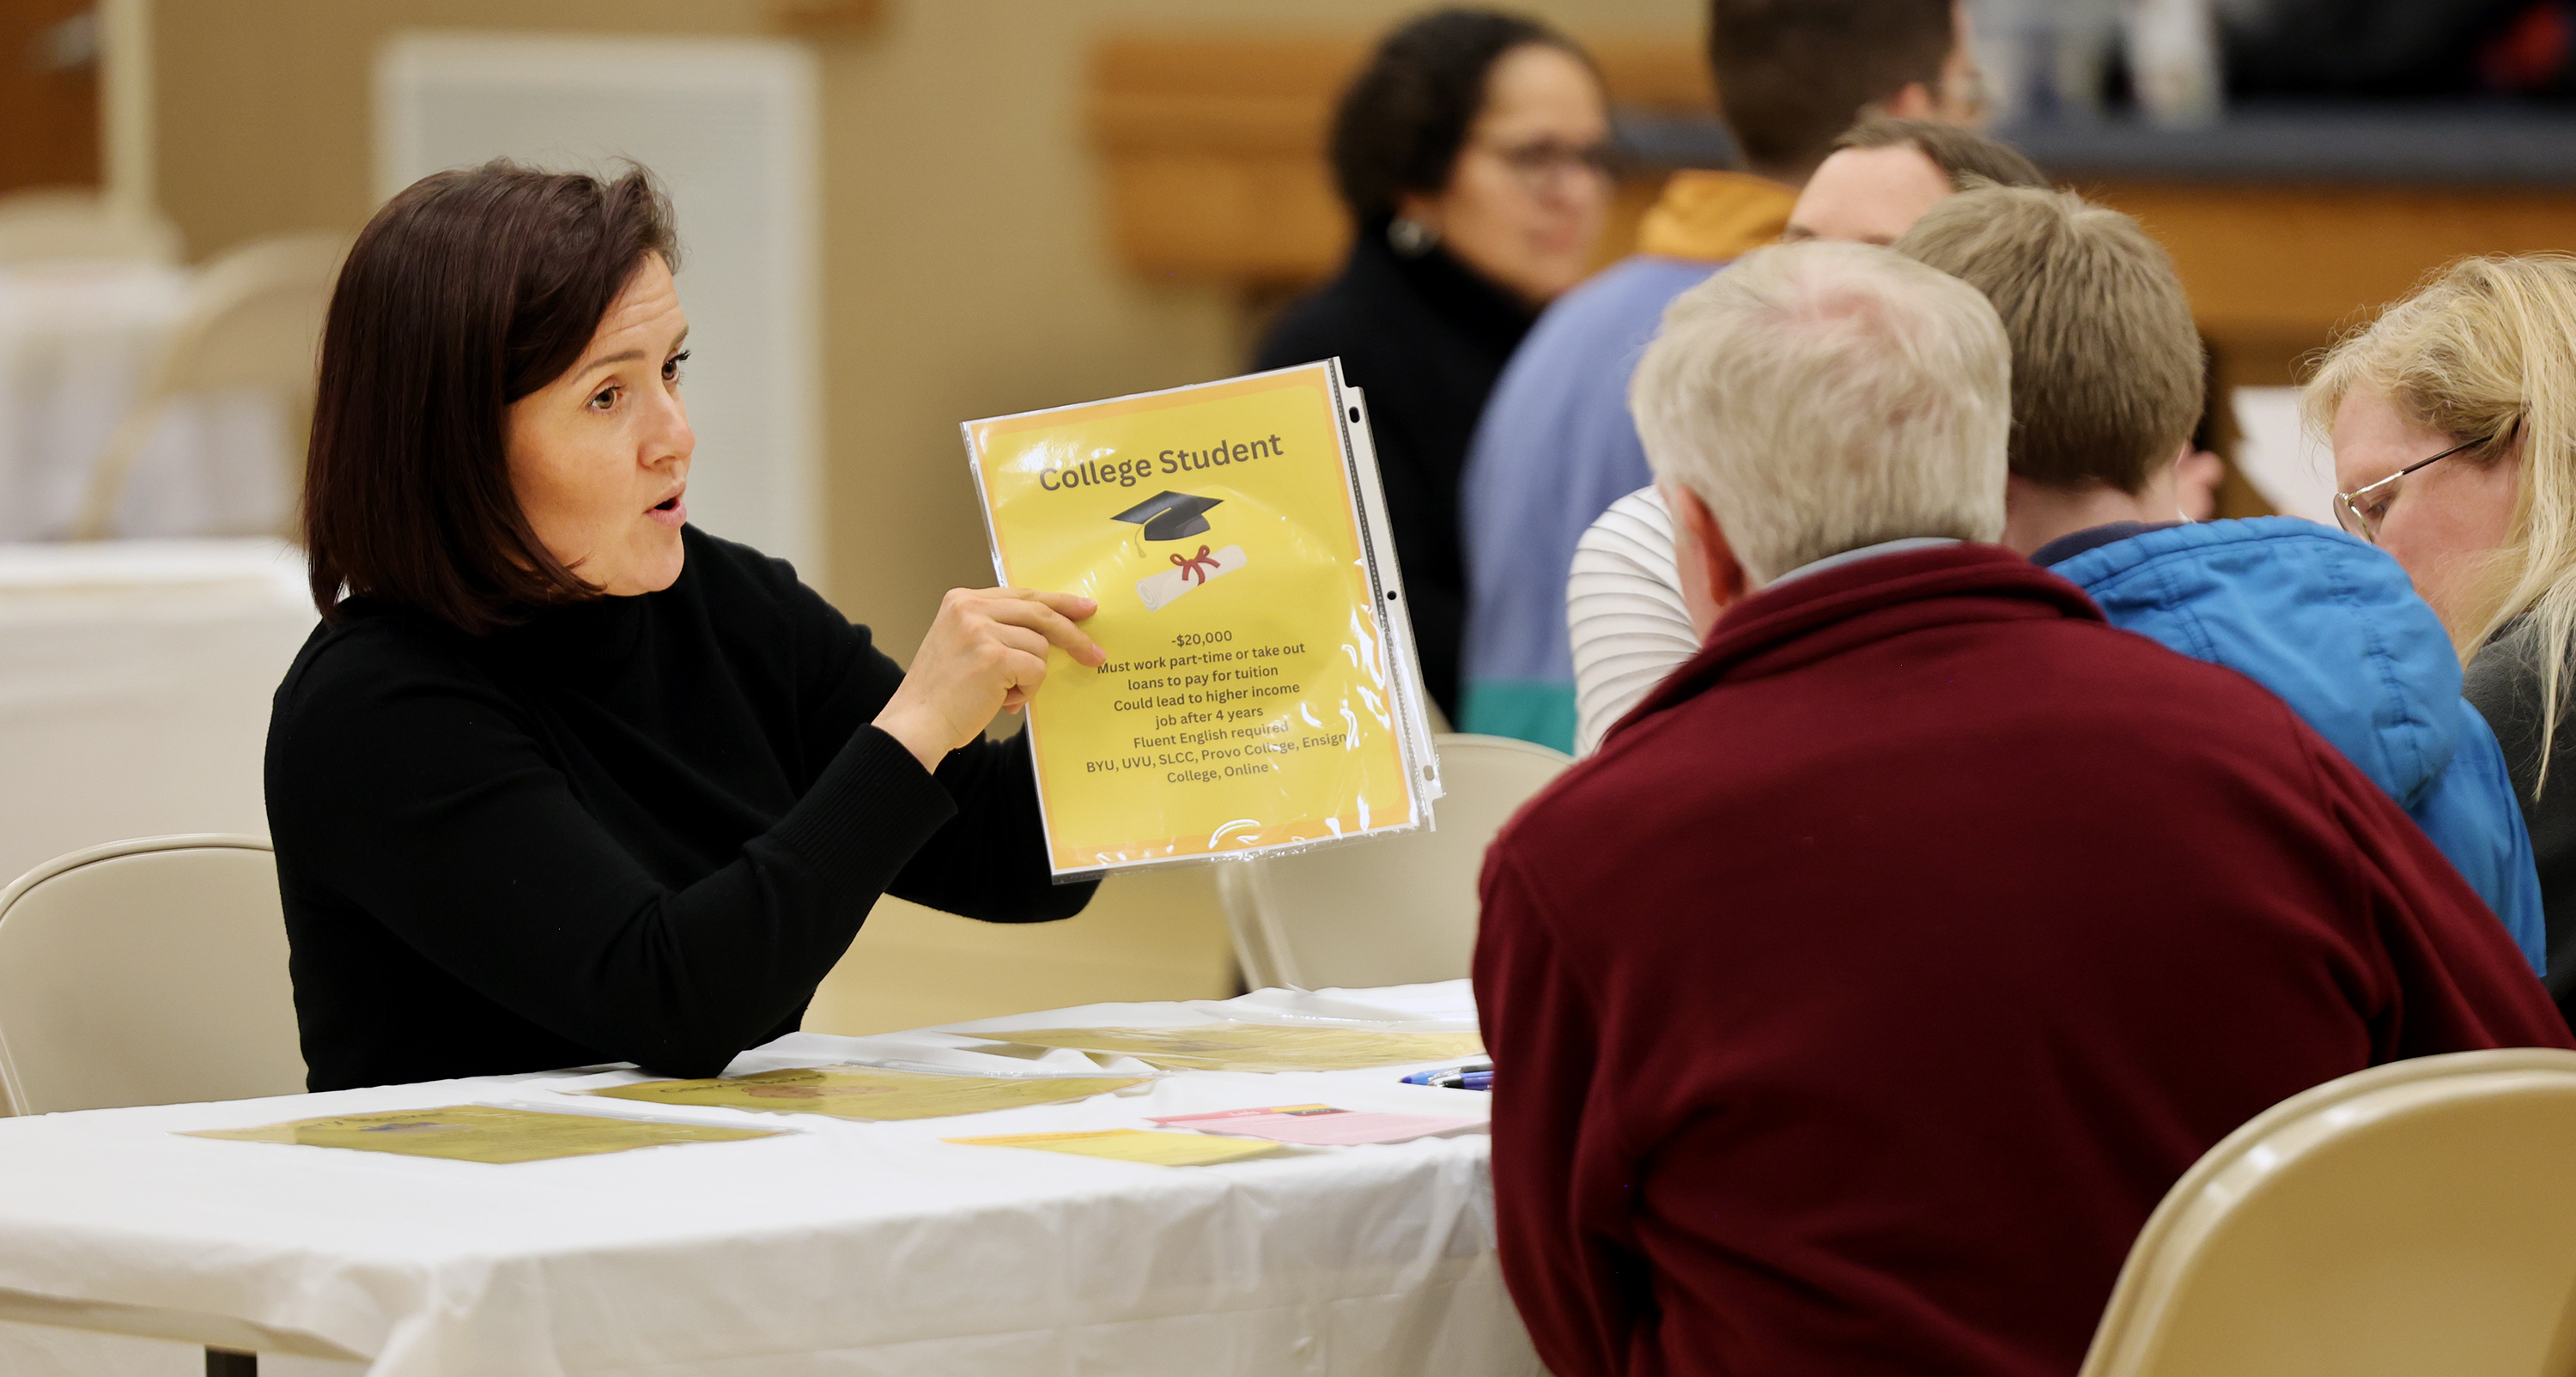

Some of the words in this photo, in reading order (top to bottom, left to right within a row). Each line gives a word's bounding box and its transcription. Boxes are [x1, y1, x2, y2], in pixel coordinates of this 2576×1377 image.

[1040, 458, 1152, 491] College
[1159, 434, 1284, 473] Student
[1171, 630, 1232, 647] -$20,000
[1097, 661, 1130, 674] Must
[1133, 657, 1166, 670] work
[1170, 651, 1232, 670] part-time
[1236, 649, 1249, 659] or
[1252, 646, 1279, 658] take
[1283, 643, 1305, 654] out
[1128, 678, 1163, 690] loans
[1167, 676, 1182, 686] to
[1185, 673, 1209, 688] pay
[1212, 670, 1231, 682] for
[1235, 666, 1279, 679] tuition
[1114, 697, 1153, 712] Could
[1157, 694, 1185, 707] lead
[1188, 694, 1202, 704] to
[1206, 688, 1248, 704] higher
[1252, 683, 1300, 697] income
[1156, 714, 1177, 730] job
[1181, 712, 1212, 725] after
[1216, 710, 1224, 720] 4
[1227, 707, 1263, 723] years
[1133, 735, 1176, 749] Fluent
[1180, 729, 1228, 744] English
[1231, 721, 1289, 738] required
[1086, 760, 1119, 773] BYU,
[1122, 755, 1156, 768] UVU,
[1158, 751, 1199, 765] SLCC,
[1201, 748, 1241, 761] Provo
[1303, 733, 1347, 748] Ensign
[1167, 769, 1222, 783] College,
[1224, 763, 1269, 777] Online
